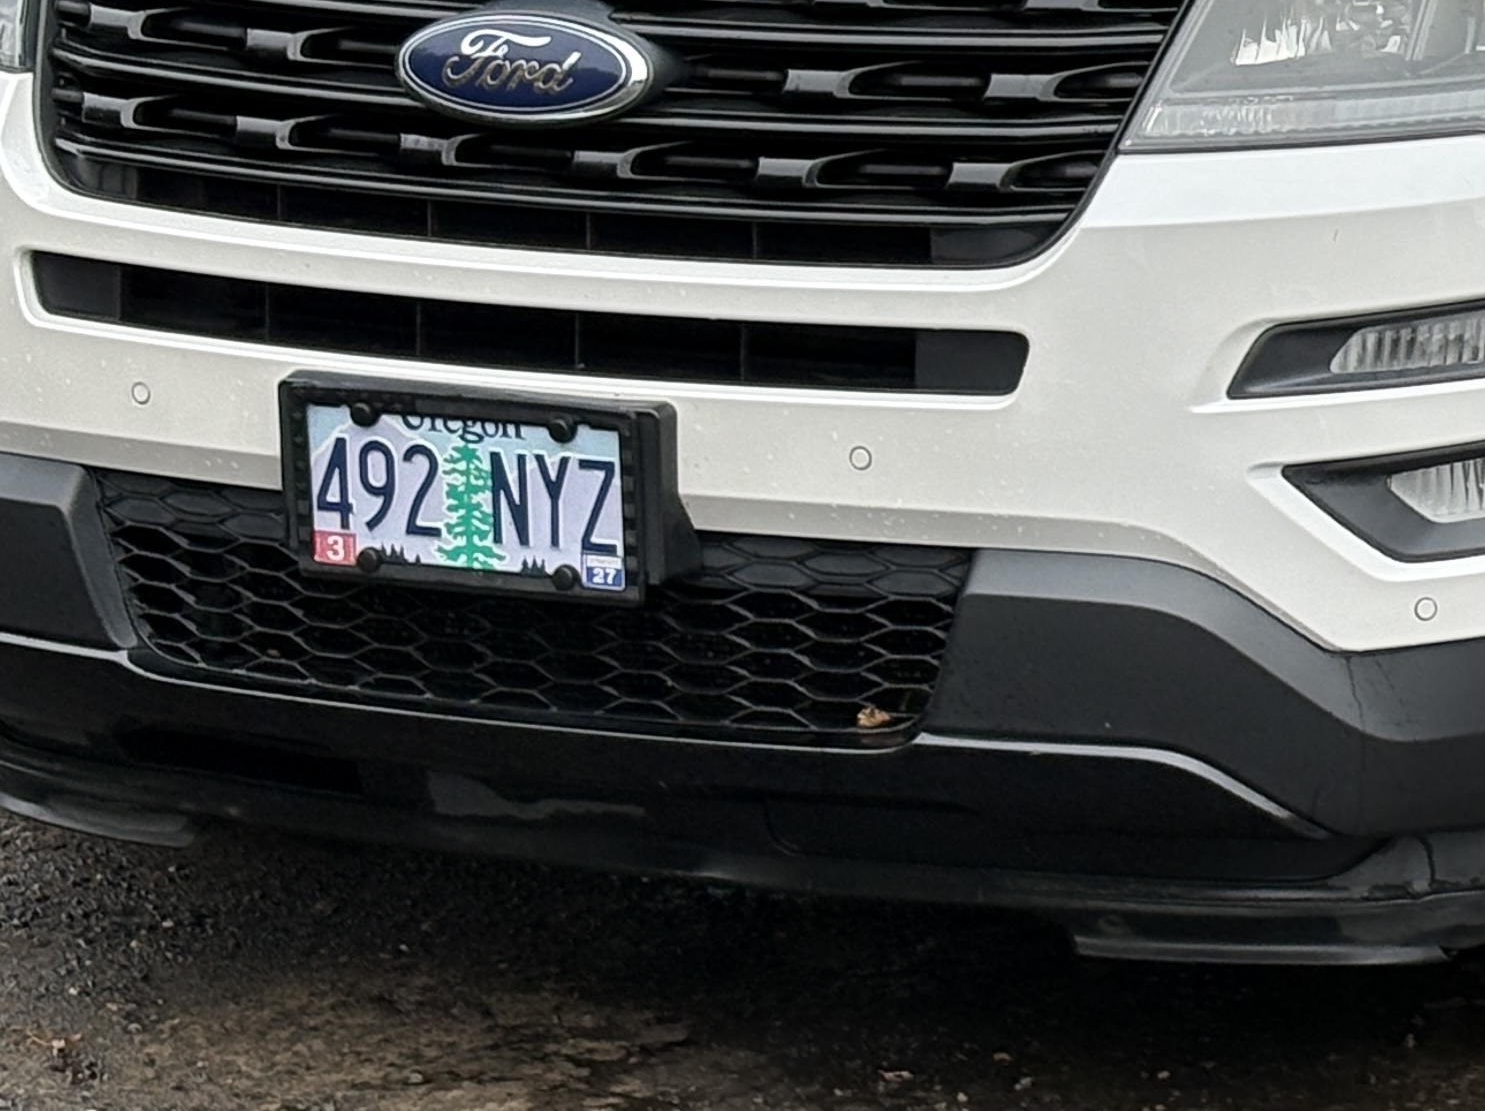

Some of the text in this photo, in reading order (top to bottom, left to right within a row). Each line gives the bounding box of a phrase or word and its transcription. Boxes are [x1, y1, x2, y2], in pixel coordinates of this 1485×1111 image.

[441, 28, 581, 94] Ford
[316, 437, 617, 555] 492 NYZ
[325, 535, 345, 561] 3
[591, 568, 617, 585] 27
